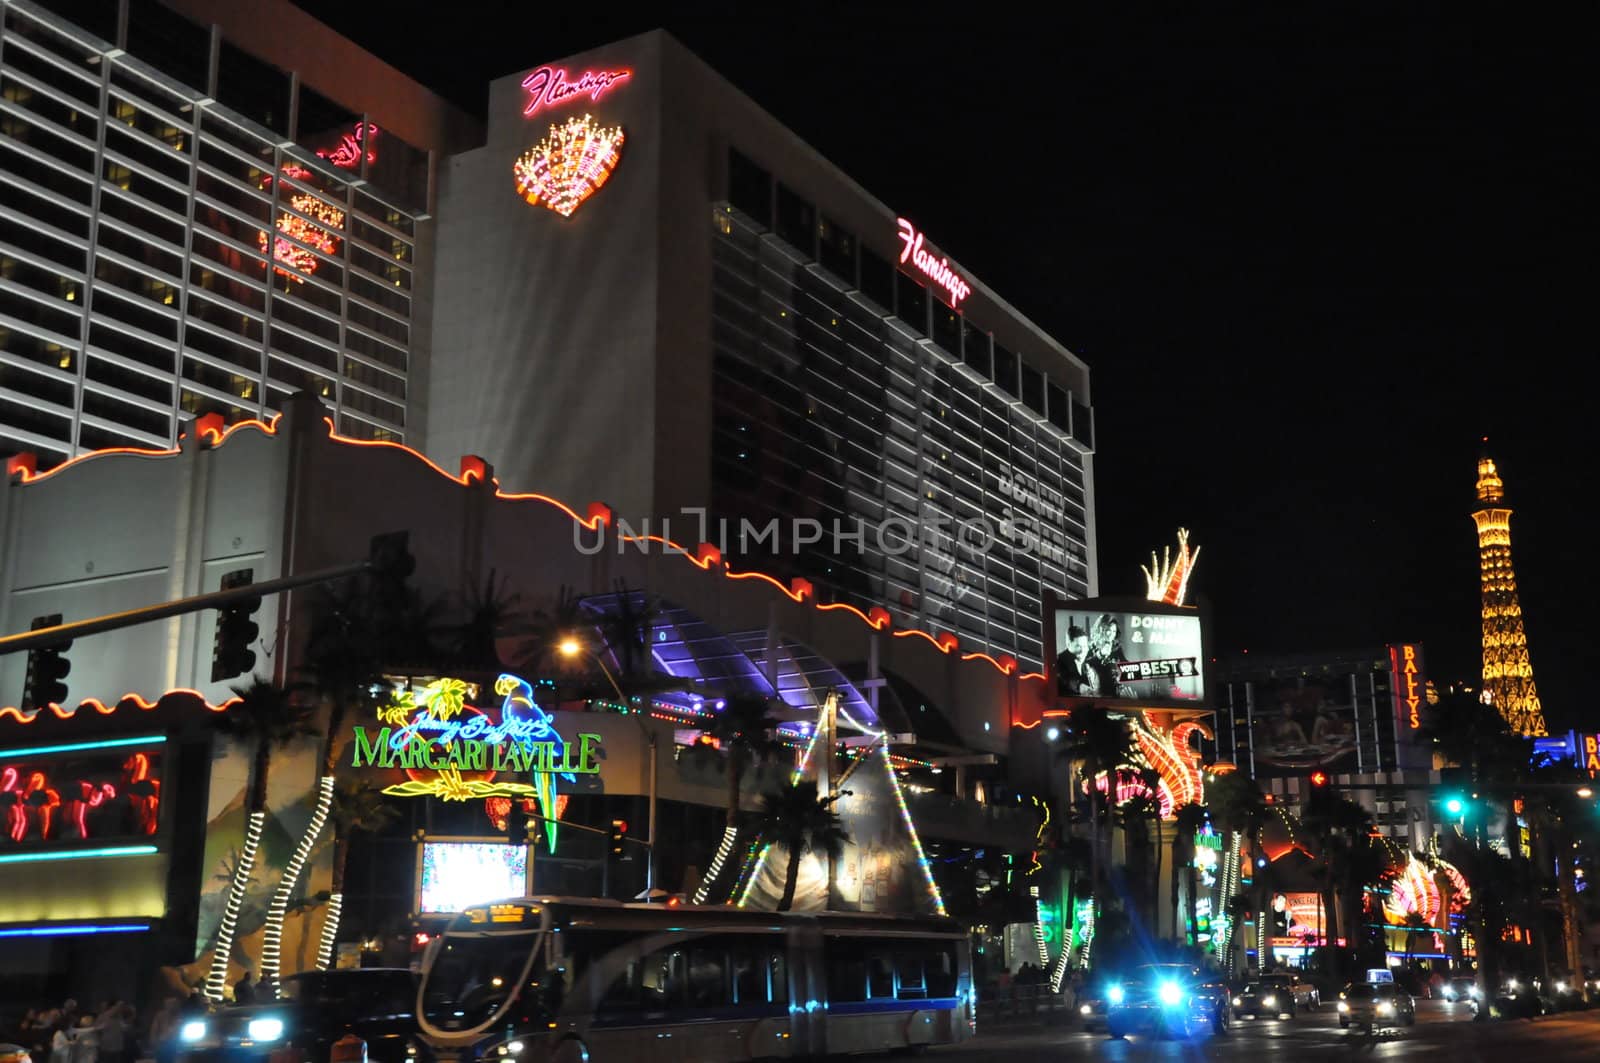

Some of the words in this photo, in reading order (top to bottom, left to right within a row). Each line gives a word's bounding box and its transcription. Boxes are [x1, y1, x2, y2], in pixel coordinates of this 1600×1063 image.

[521, 66, 630, 114] Flamingo
[897, 217, 971, 308] Flamingo
[1140, 661, 1178, 676] BEST
[1403, 646, 1420, 728] BALLYS
[351, 726, 602, 773] MARGARITAVILLE
